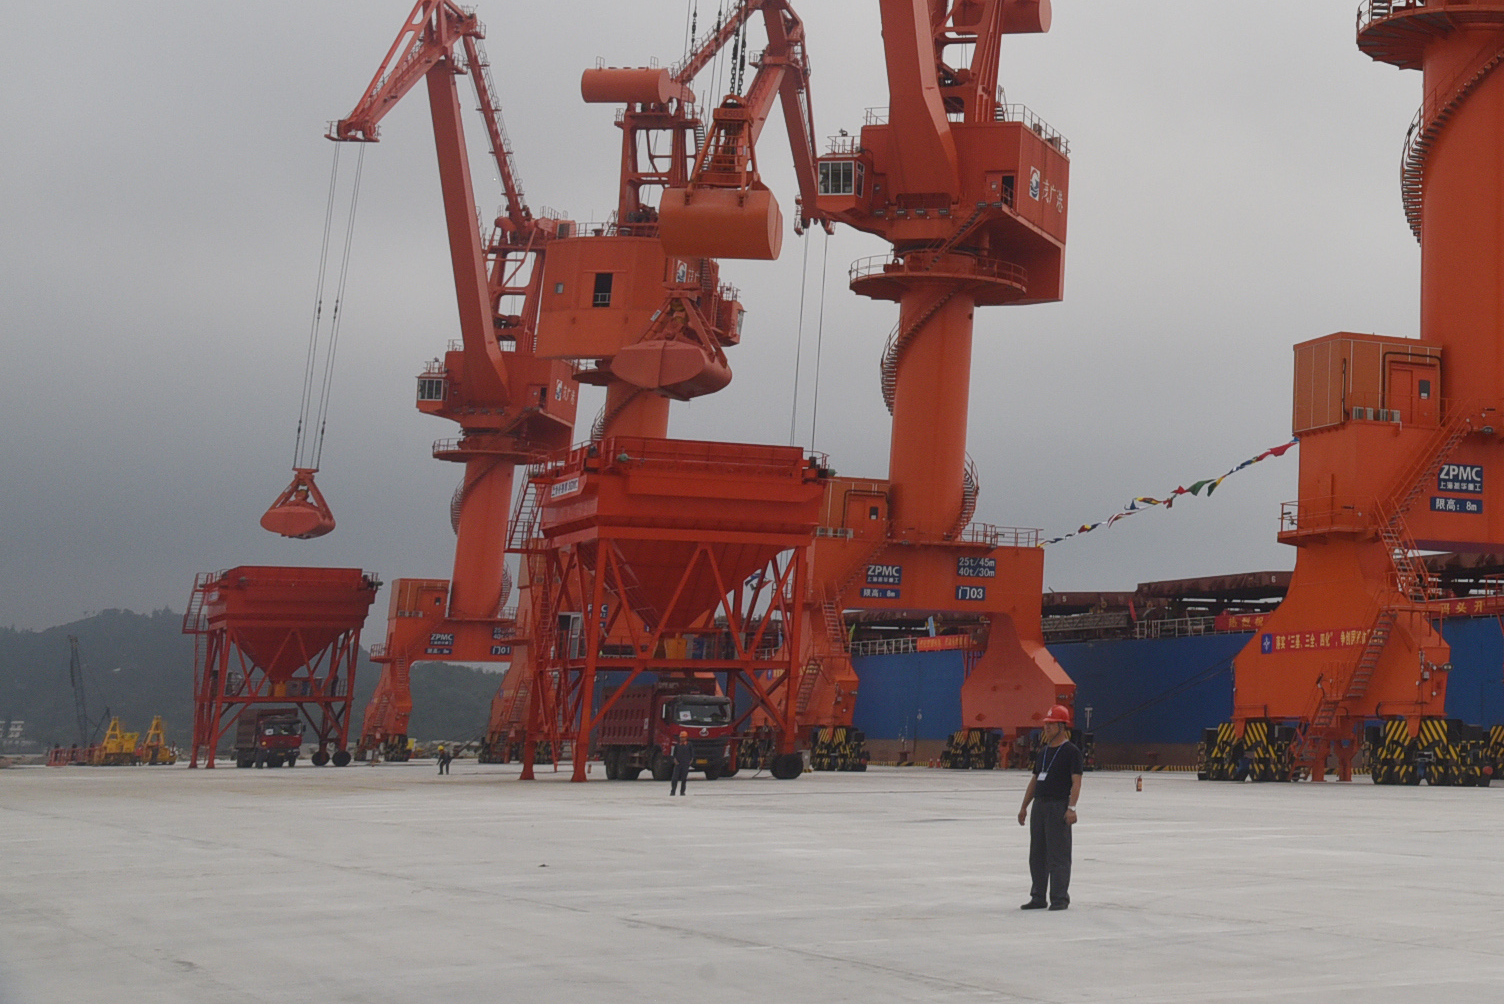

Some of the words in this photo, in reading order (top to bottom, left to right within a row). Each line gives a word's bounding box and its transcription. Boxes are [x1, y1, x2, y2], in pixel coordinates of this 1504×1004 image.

[1440, 465, 1482, 481] ZPMC
[867, 565, 900, 576] ZPMC
[958, 586, 983, 599] 门03
[431, 633, 454, 641] ZPMC
